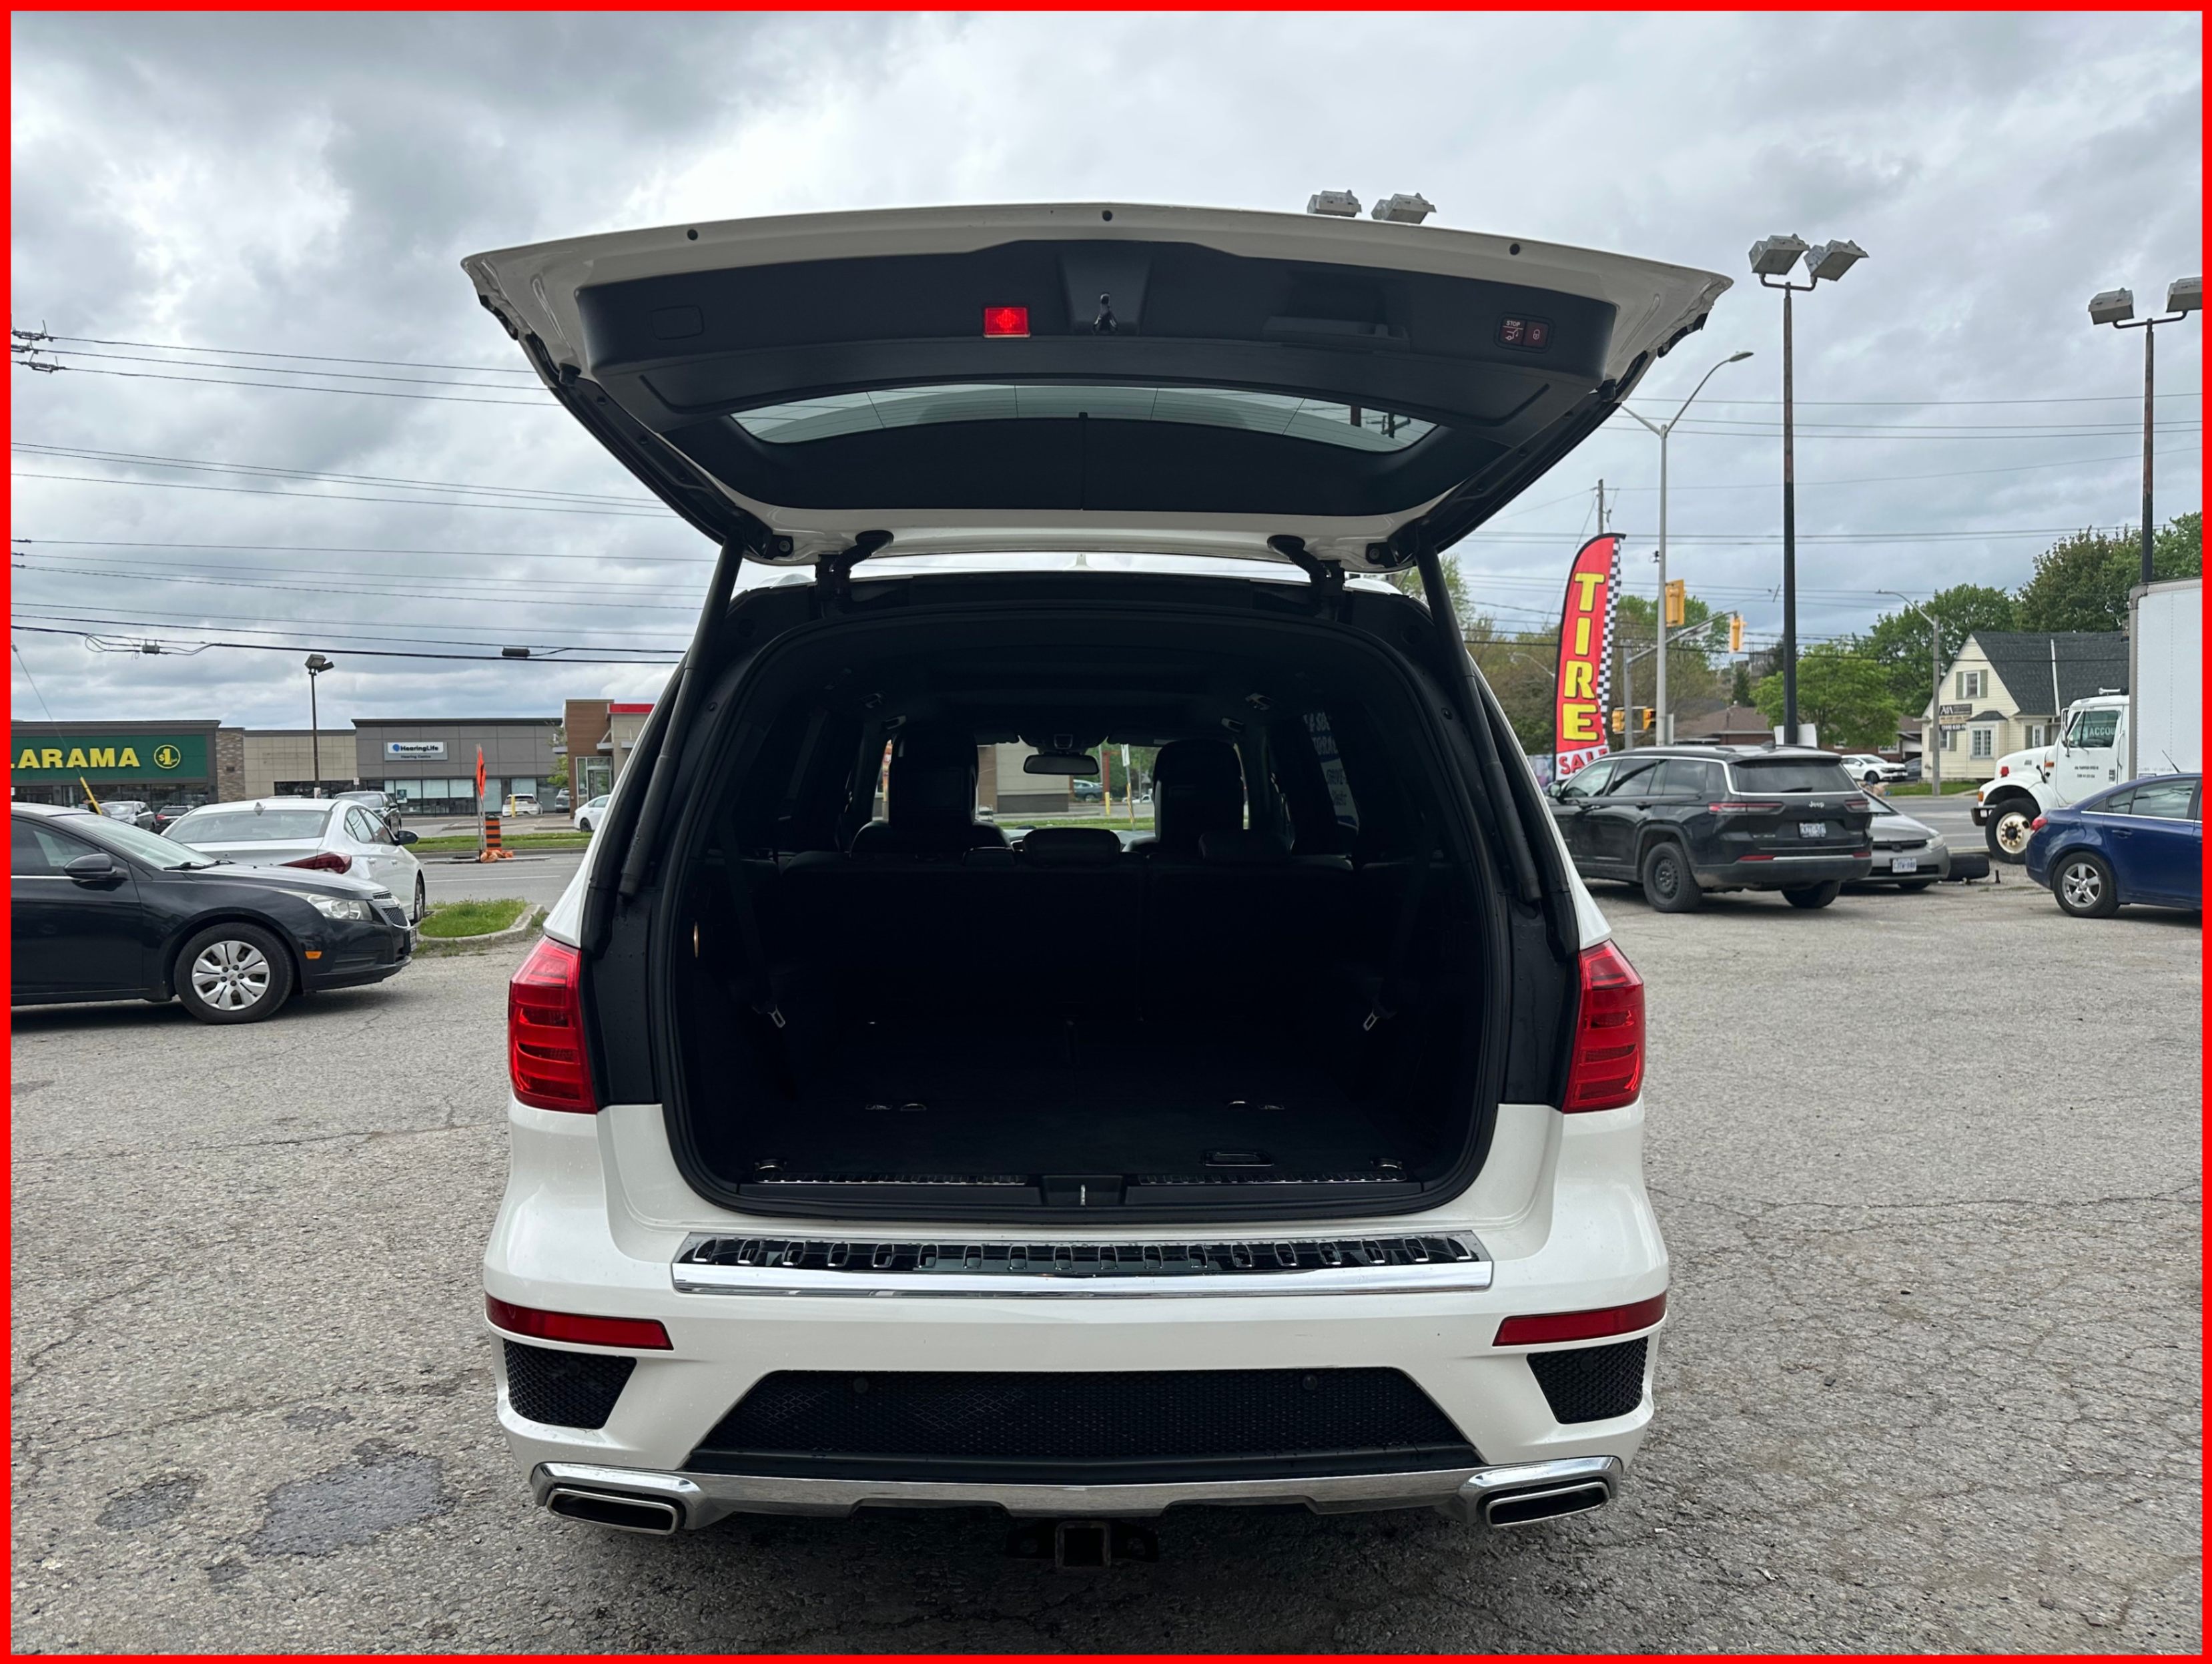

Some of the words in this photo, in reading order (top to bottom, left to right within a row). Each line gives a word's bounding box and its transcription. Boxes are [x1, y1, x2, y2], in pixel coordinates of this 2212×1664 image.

[1562, 572, 1605, 742] TIRE
[11, 748, 141, 769] ARAMA
[1808, 800, 1825, 808] Jeep
